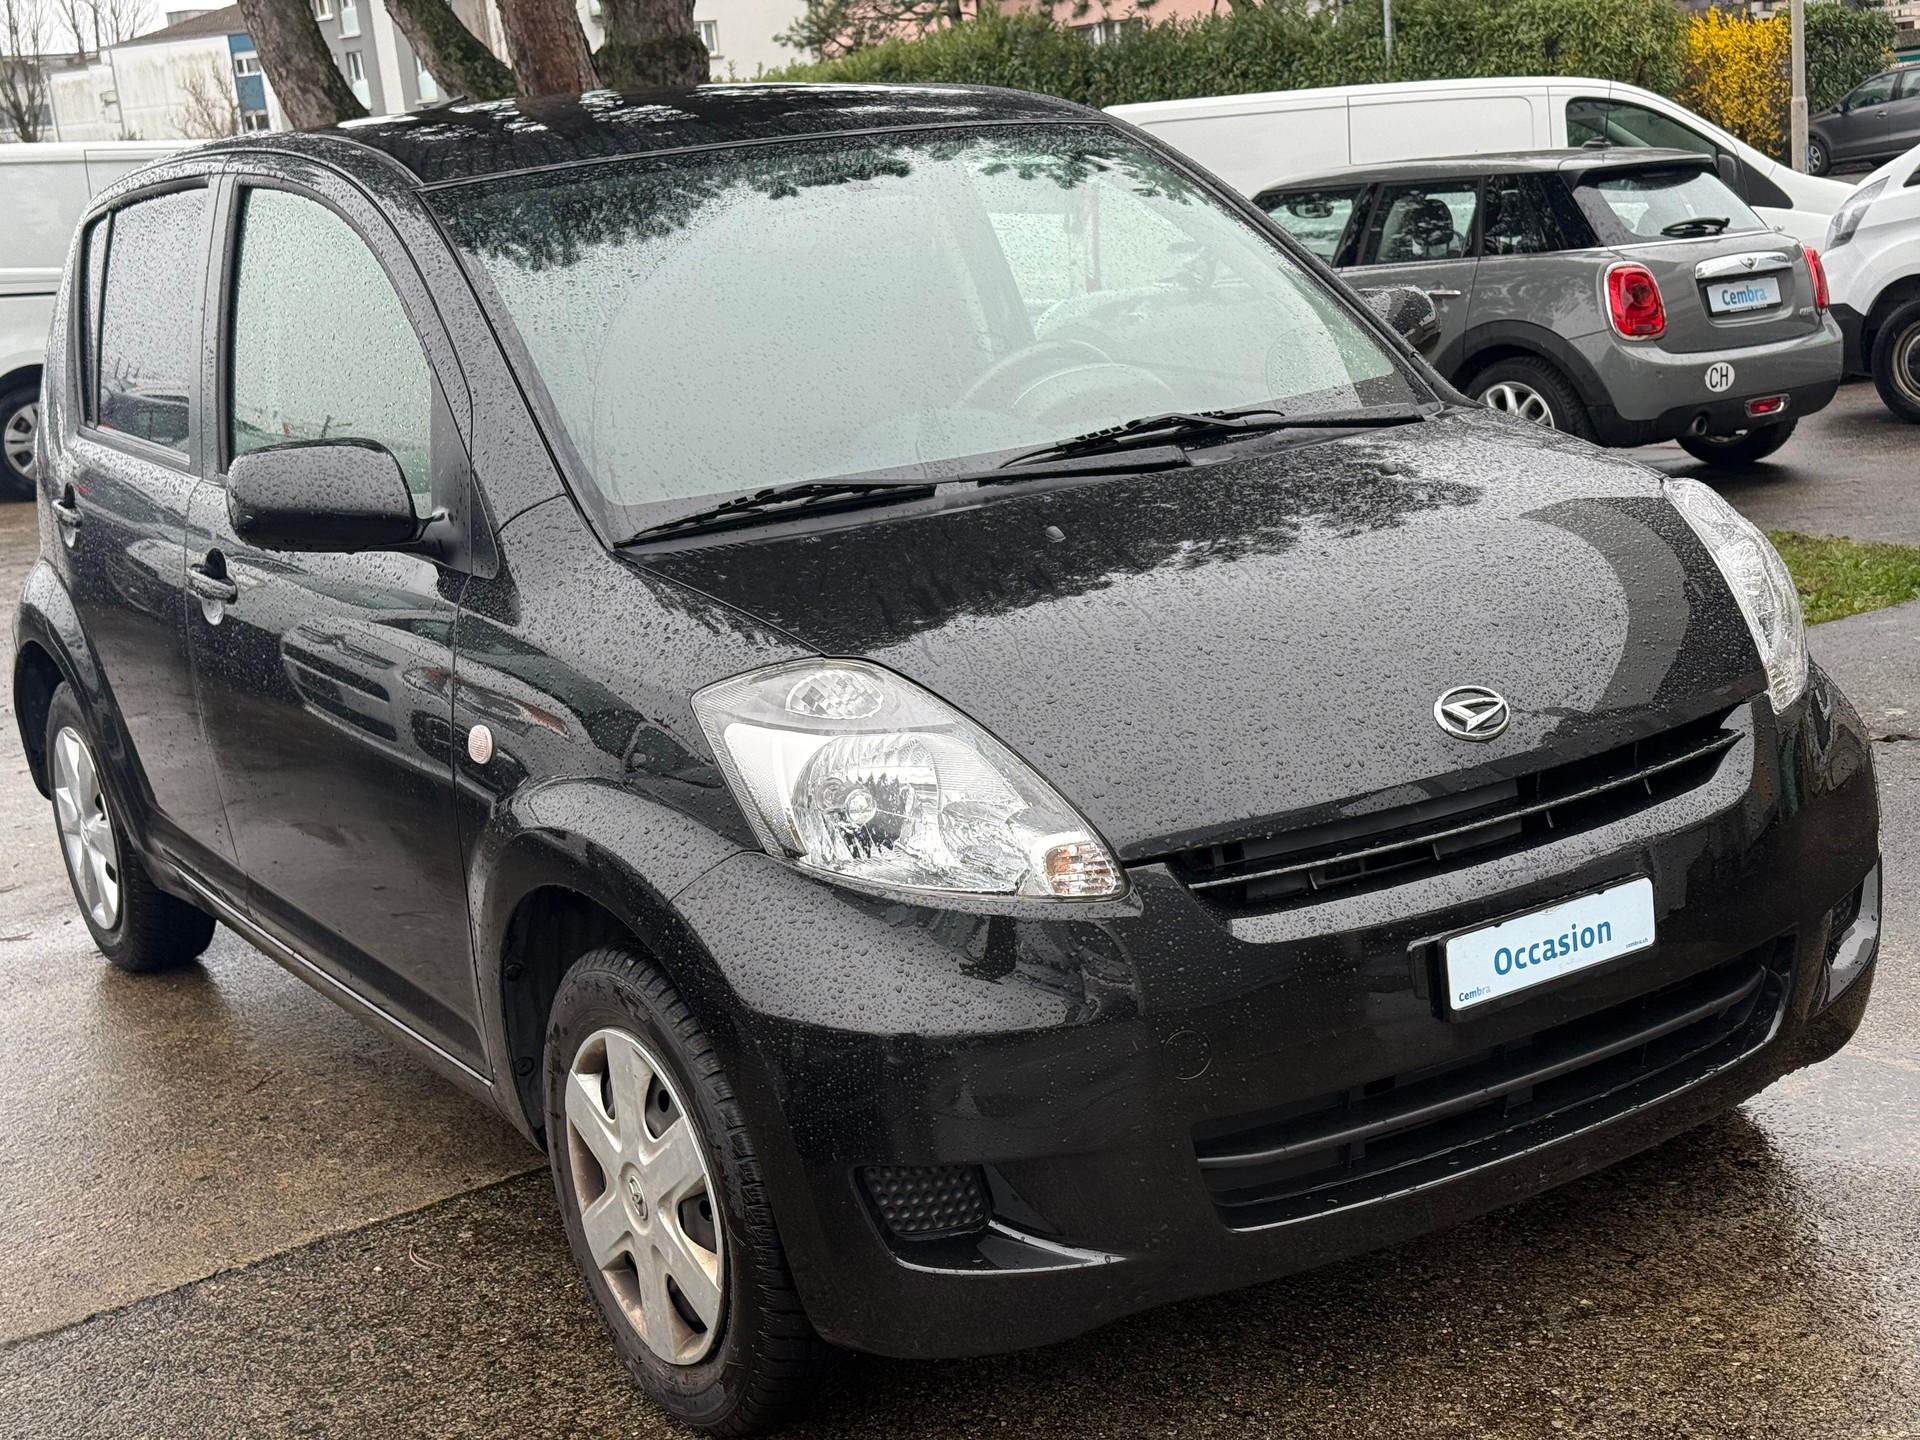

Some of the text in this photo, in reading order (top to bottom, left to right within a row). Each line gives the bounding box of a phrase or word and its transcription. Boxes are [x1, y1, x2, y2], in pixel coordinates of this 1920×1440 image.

[1721, 285, 1767, 305] Cembra
[1709, 366, 1729, 388] CH
[1494, 921, 1612, 976] Occasion
[1459, 985, 1491, 1002] Cembra
